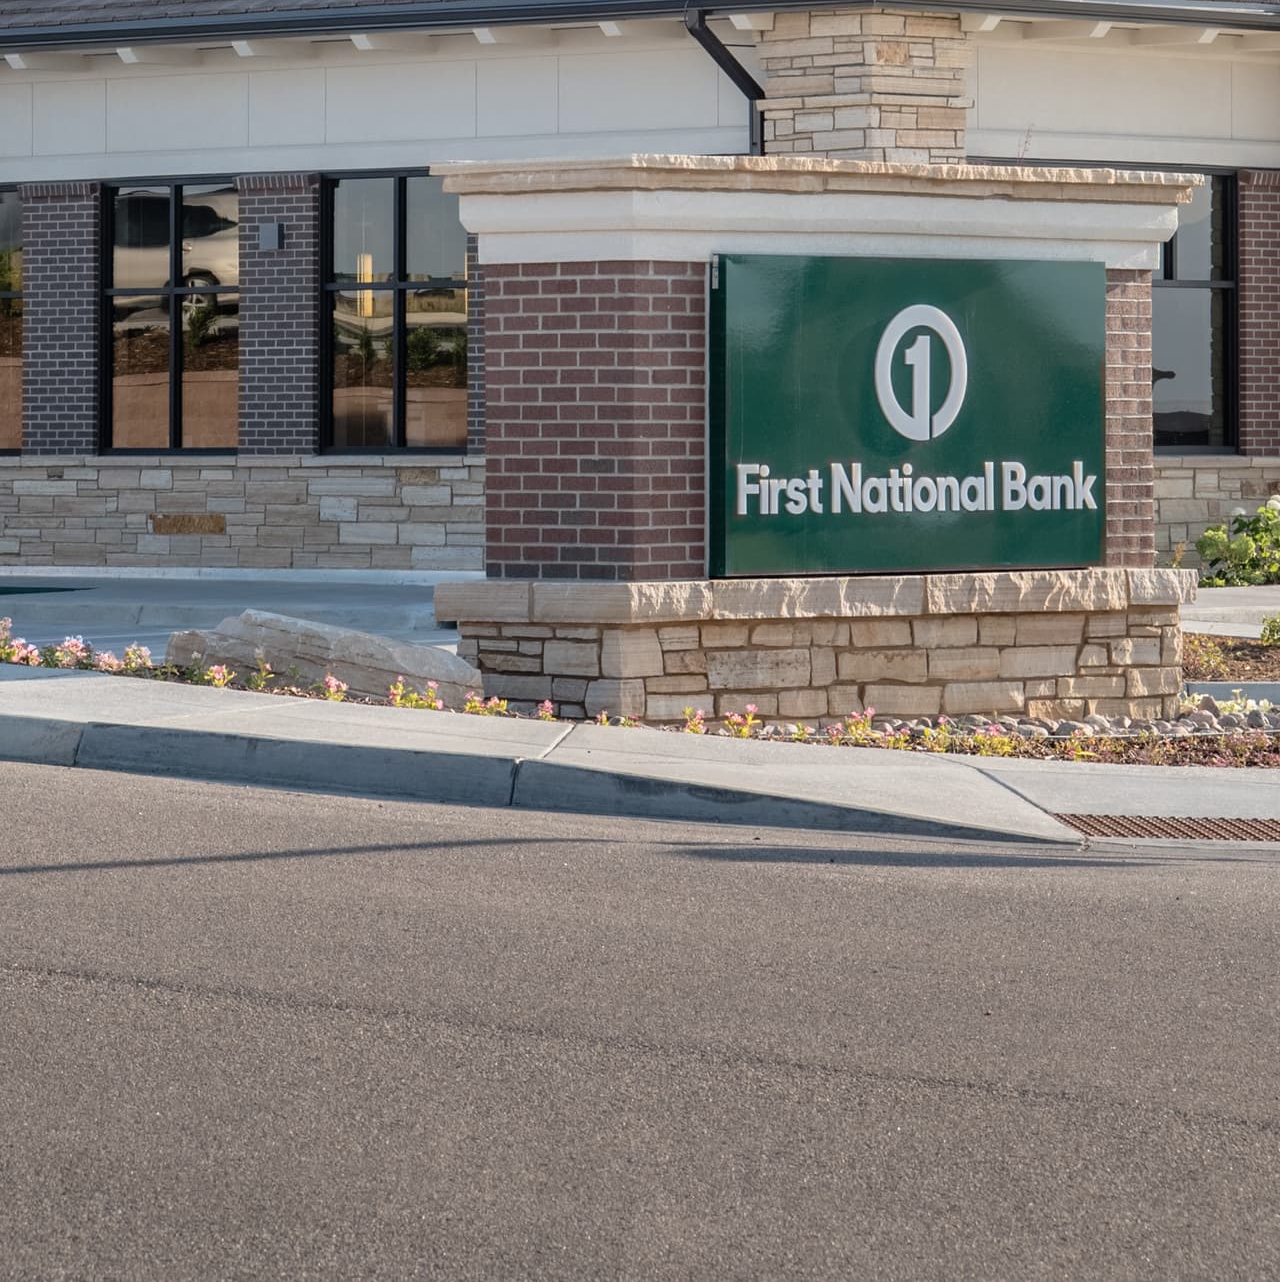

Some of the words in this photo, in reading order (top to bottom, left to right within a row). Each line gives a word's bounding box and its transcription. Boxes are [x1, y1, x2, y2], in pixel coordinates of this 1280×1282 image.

[737, 463, 823, 515] First
[831, 461, 994, 514] National
[1001, 460, 1098, 511] Bank
